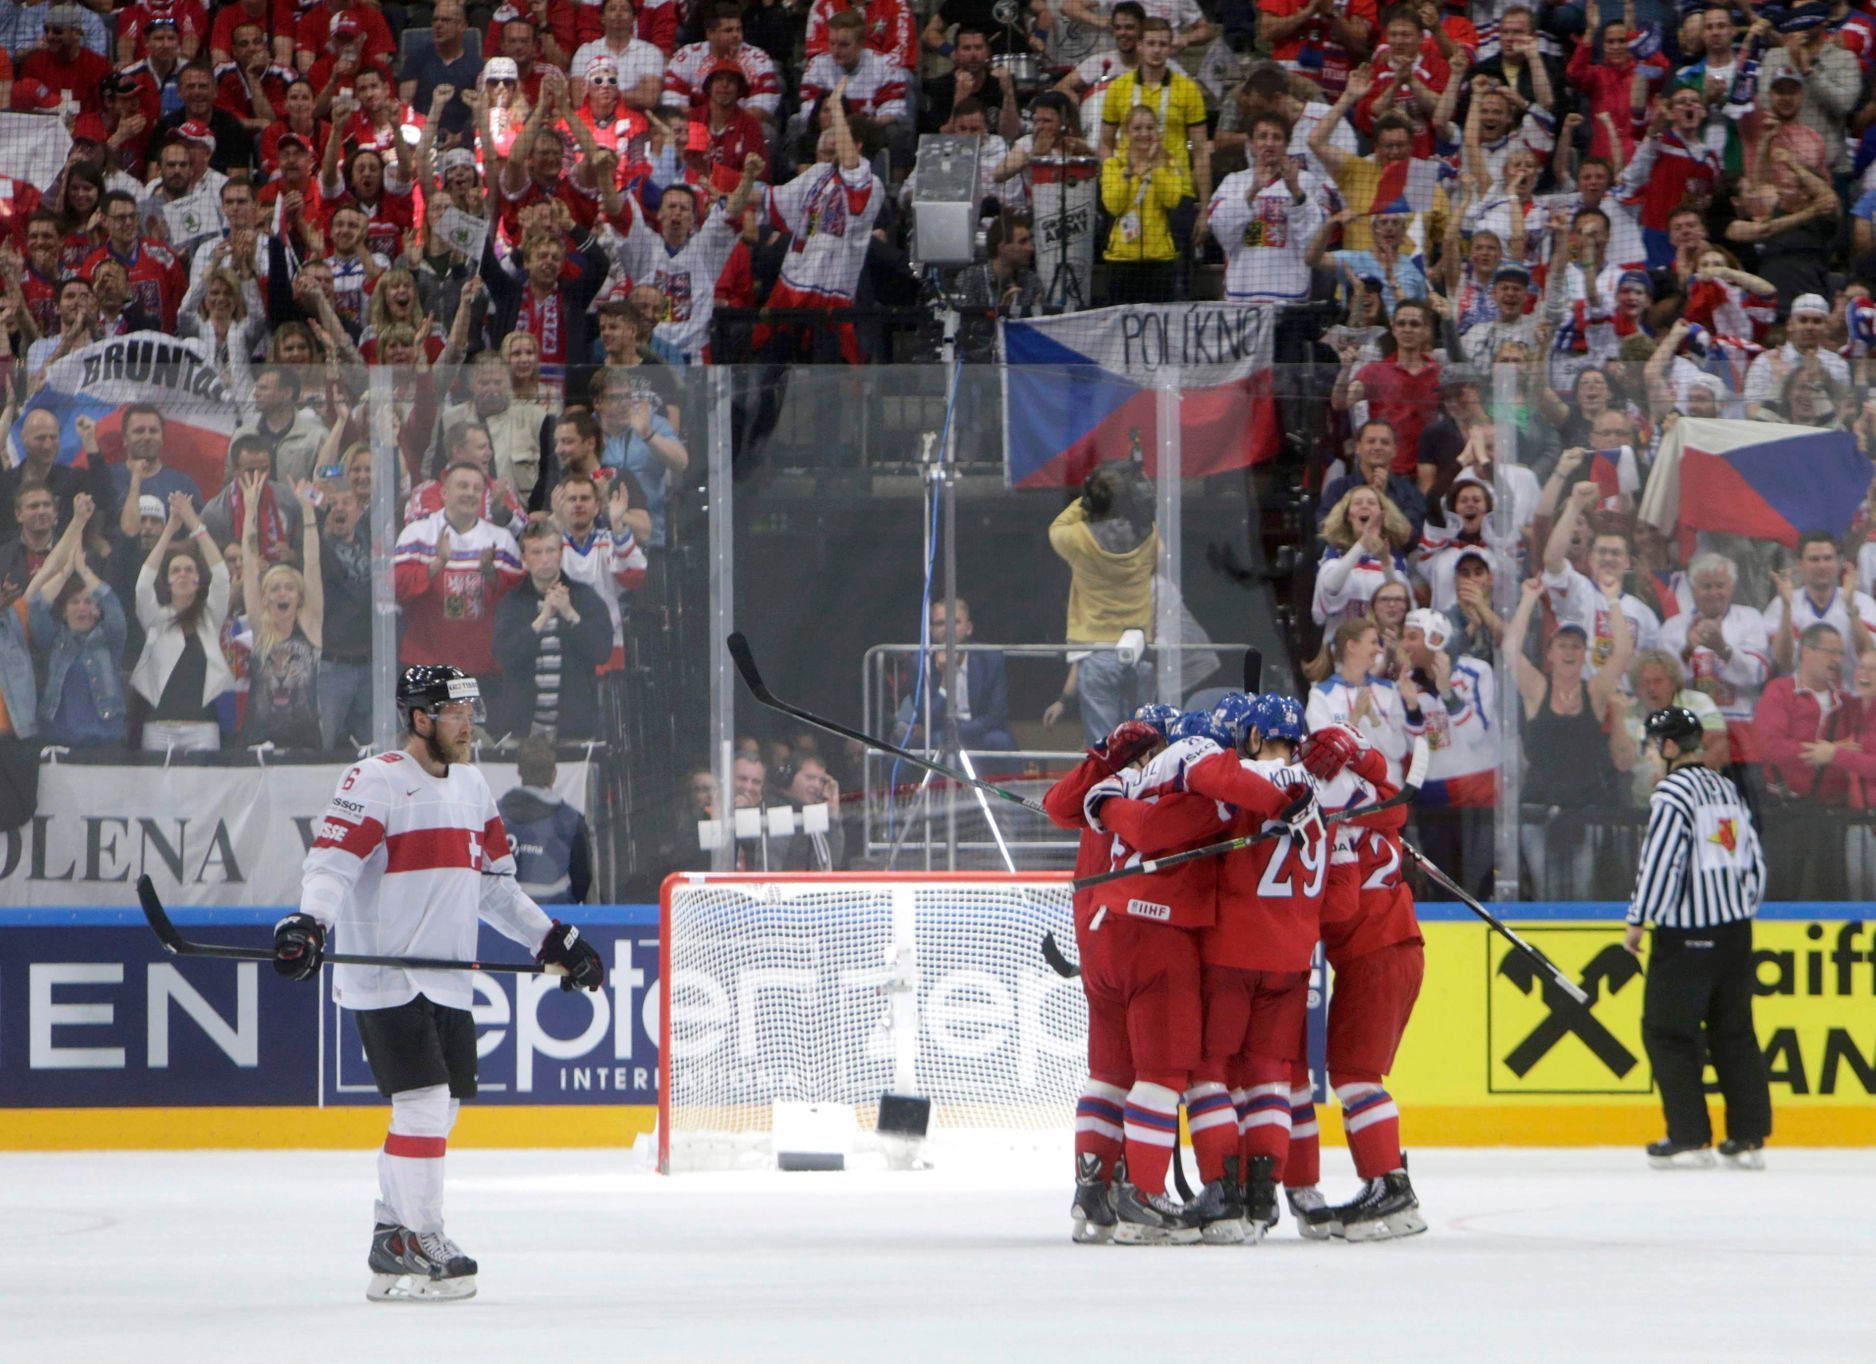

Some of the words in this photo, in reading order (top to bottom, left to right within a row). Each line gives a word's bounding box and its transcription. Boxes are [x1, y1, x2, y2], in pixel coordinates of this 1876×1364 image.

[341, 767, 362, 791] 6
[332, 797, 366, 814] SSOT
[319, 821, 350, 842] SSE
[1256, 819, 1327, 898] 29
[1138, 903, 1168, 918] IIHF
[1748, 921, 1876, 997] aif
[29, 963, 259, 1069] EN
[1757, 1027, 1876, 1095] AN
